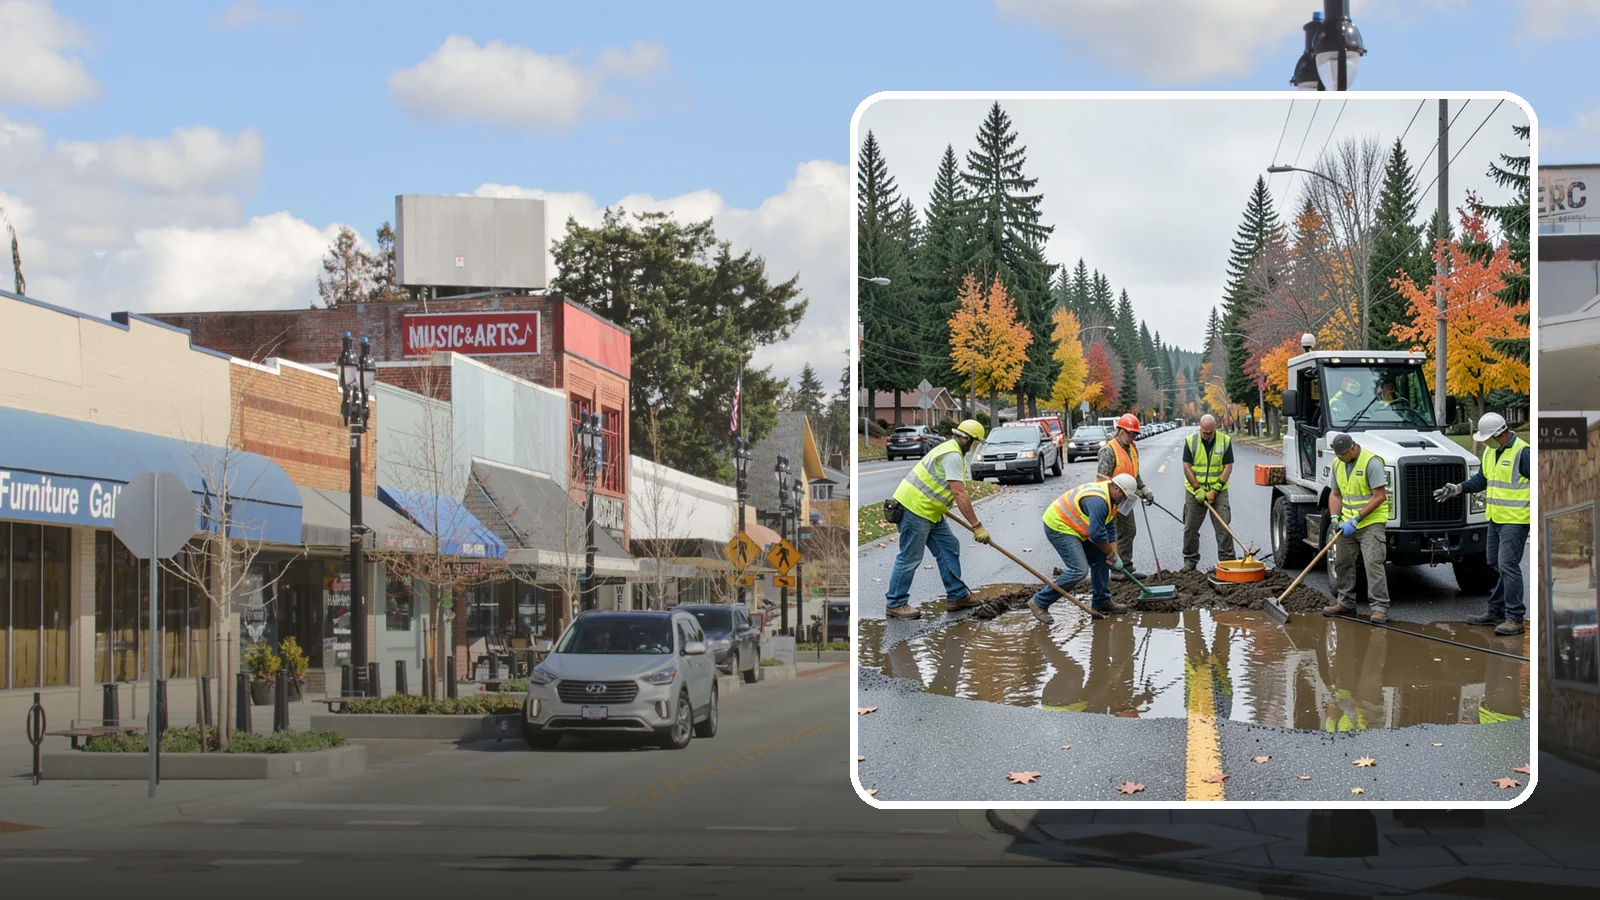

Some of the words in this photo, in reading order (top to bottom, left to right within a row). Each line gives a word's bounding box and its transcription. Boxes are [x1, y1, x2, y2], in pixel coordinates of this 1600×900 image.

[409, 323, 519, 349] MUSIC&ARTS
[0, 472, 79, 515] Furniture
[453, 563, 479, 574] SUSHI
